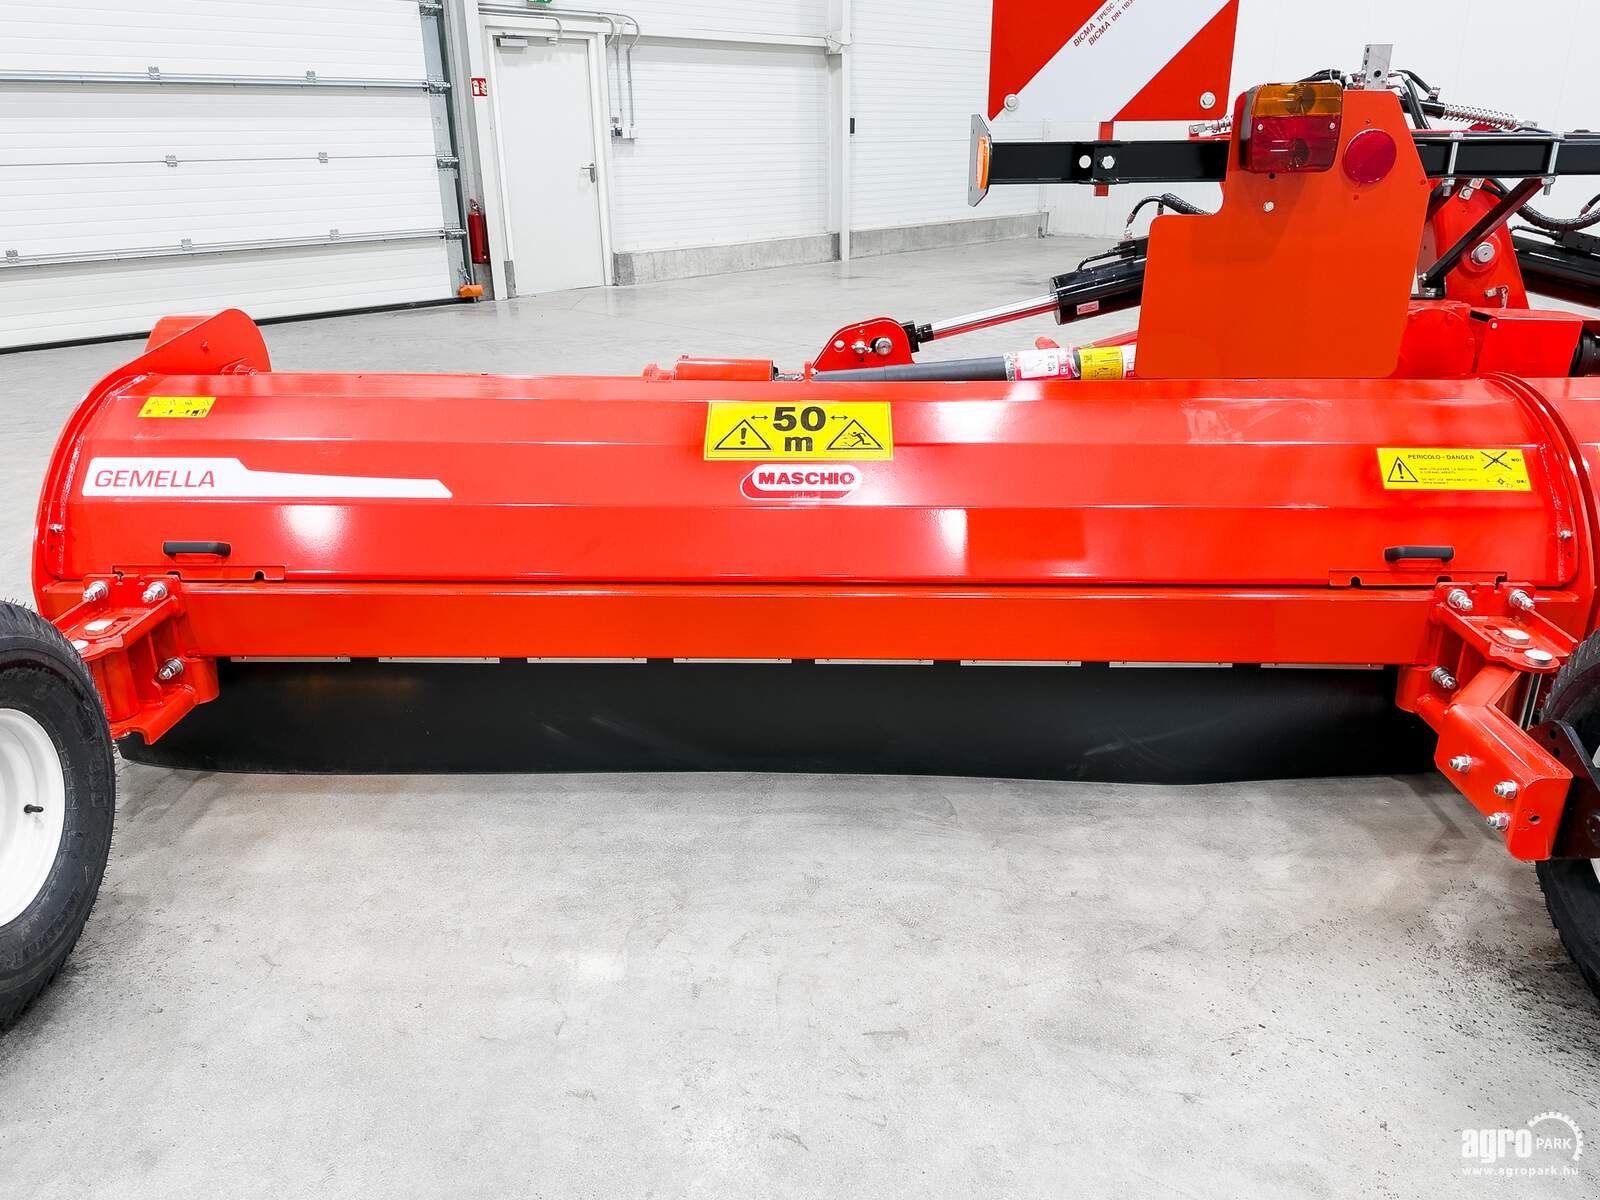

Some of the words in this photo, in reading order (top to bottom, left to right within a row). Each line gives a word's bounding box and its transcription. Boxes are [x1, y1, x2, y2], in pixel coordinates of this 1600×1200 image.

[1073, 22, 1096, 47] BICMA
[1088, 21, 1111, 46] BICMA
[773, 406, 826, 431] 50
[784, 436, 813, 451] m
[94, 470, 215, 488] GEMELLA
[758, 472, 855, 485] MASCHIO
